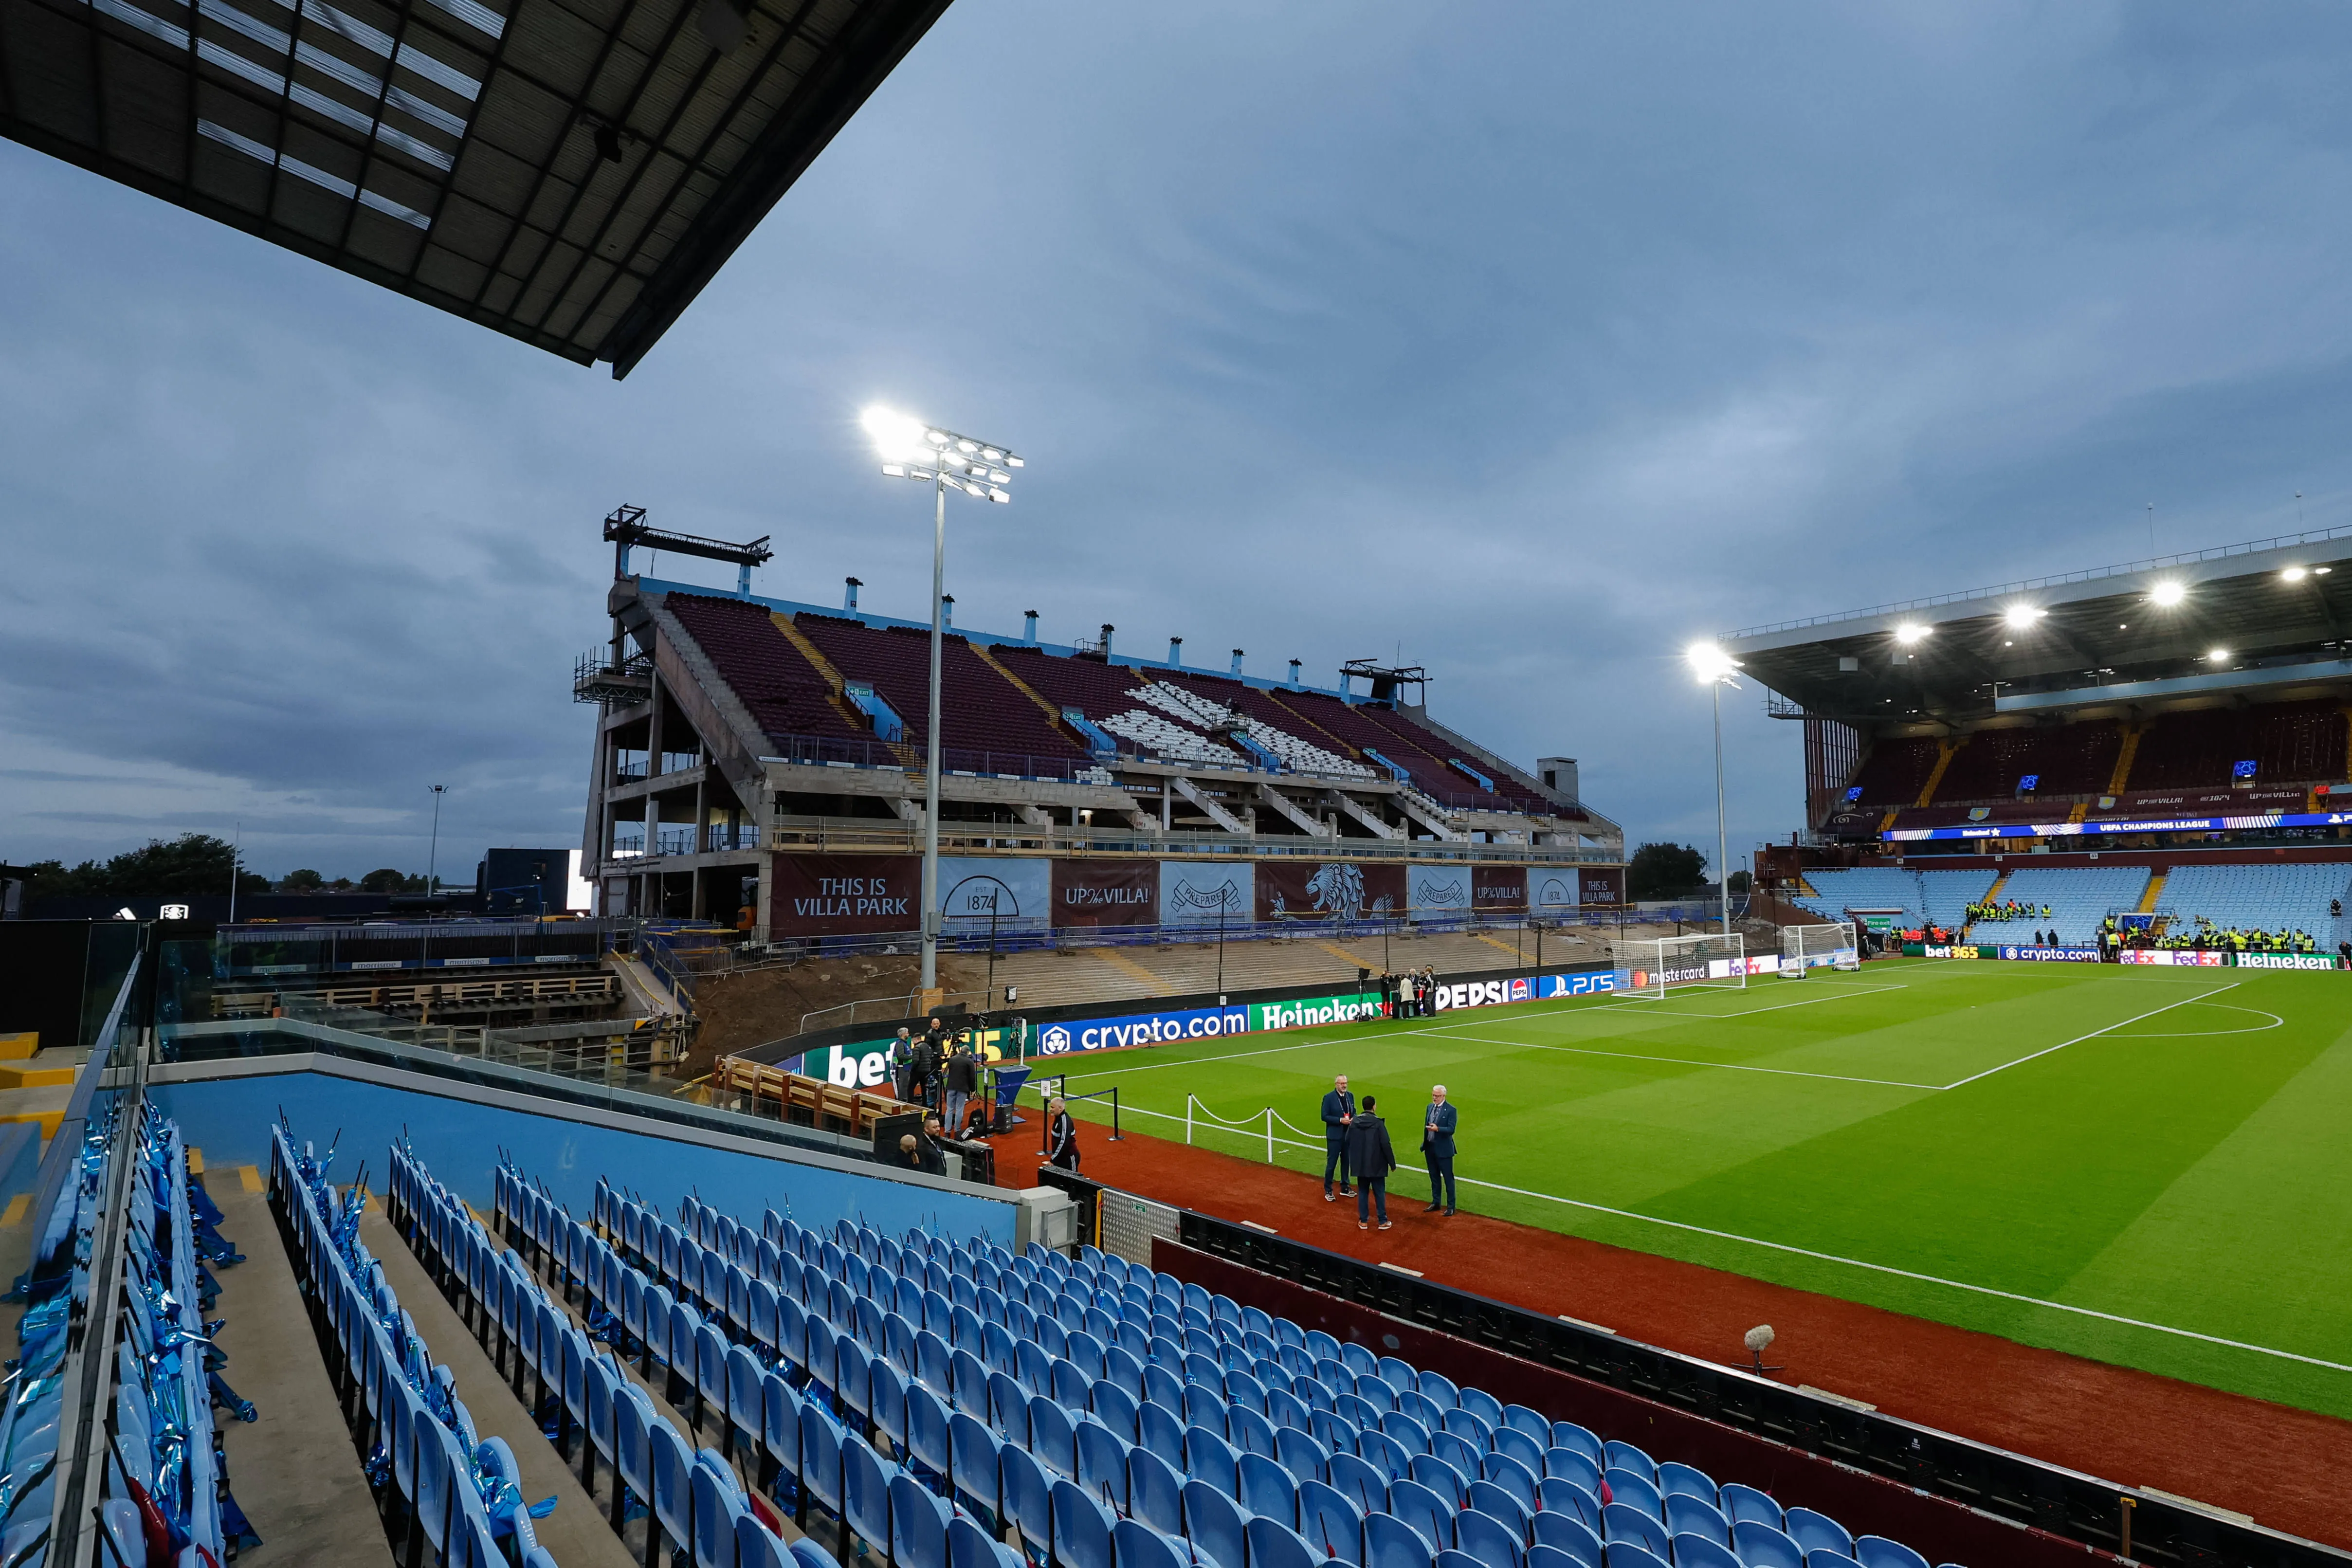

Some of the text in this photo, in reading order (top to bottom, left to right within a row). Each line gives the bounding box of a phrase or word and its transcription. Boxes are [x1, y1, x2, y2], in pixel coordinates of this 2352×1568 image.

[2122, 821, 2174, 831] CHAMPIONS
[2174, 820, 2210, 829] LEAGUE
[819, 878, 886, 895] THIS IS
[1477, 887, 1488, 898] UP
[1495, 887, 1520, 898] VILLA!
[1587, 881, 1608, 891] THIS IS
[967, 894, 995, 911] 1874
[1065, 888, 1087, 904] UP
[1103, 888, 1149, 904] VILLA!
[1184, 887, 1228, 905] PREPARED
[1424, 887, 1456, 902] PREPARED
[1548, 891, 1560, 901] 1874
[1582, 891, 1616, 902] VILLA PARK
[794, 898, 909, 916] VILLA PARK
[1925, 945, 1979, 959] bet365
[2021, 948, 2097, 962] crypto.com
[2119, 949, 2156, 965] FedEx
[2172, 950, 2221, 966] FedEx
[2236, 952, 2333, 970] Heineken
[1573, 975, 1613, 995] PS5
[1436, 980, 1509, 1010] PEPSI
[1262, 999, 1374, 1030] Heineken
[1080, 1013, 1245, 1050] crypto.com
